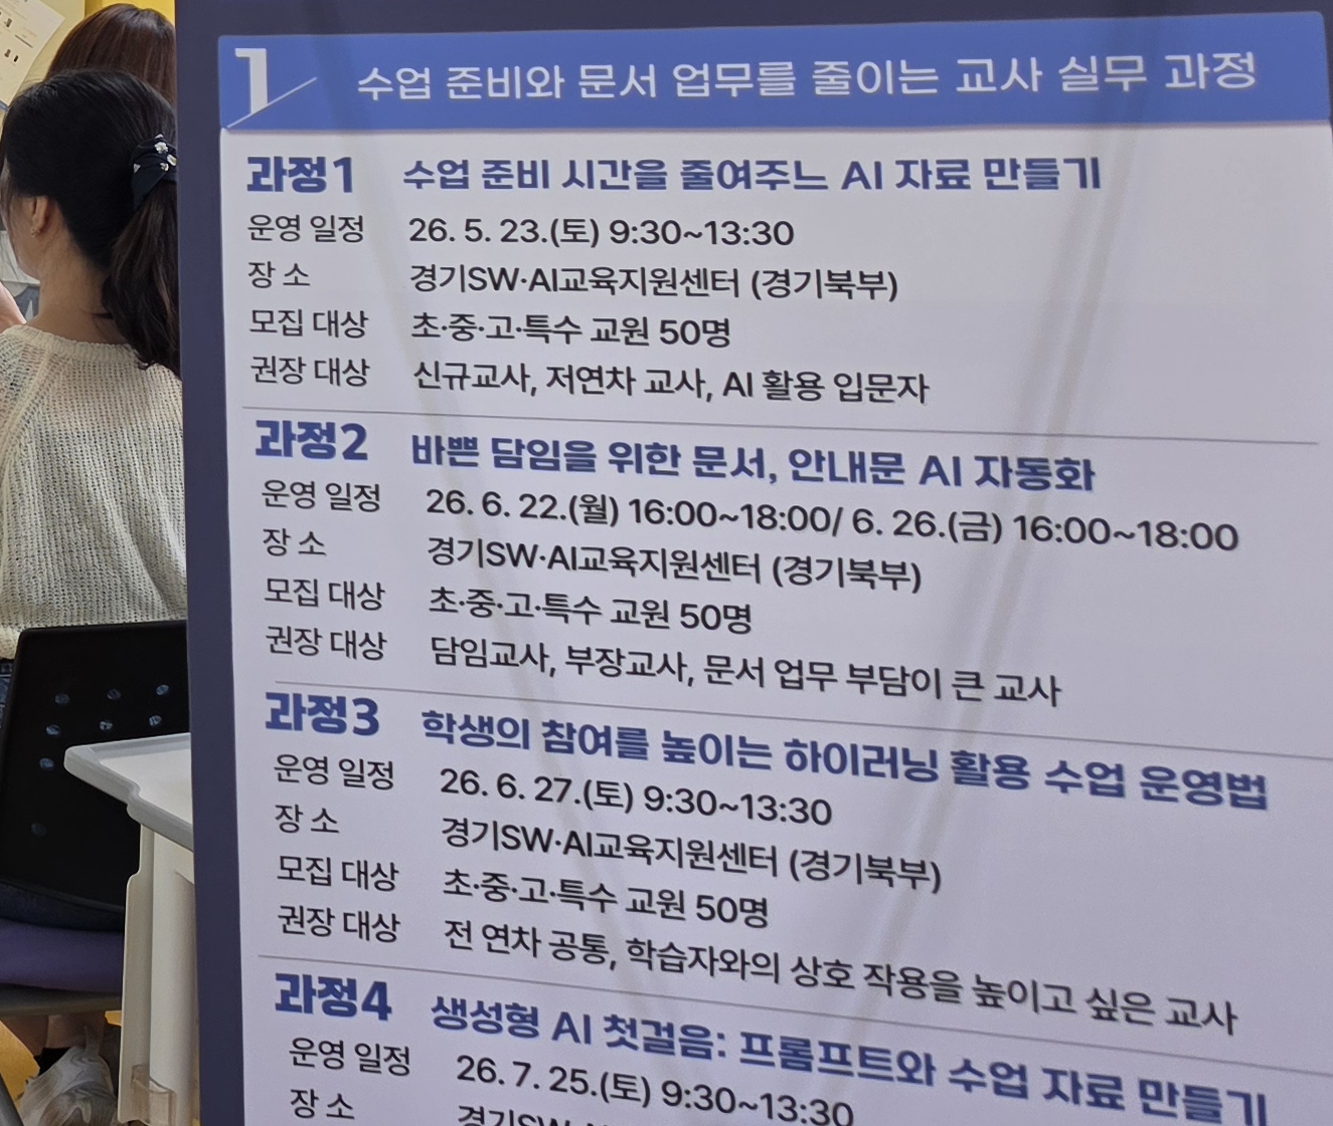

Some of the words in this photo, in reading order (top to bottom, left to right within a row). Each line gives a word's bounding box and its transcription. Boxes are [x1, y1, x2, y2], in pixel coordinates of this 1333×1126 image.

[358, 67, 430, 101] 수업
[447, 65, 565, 99] 준비와
[579, 64, 656, 98] 문서
[673, 62, 796, 97] 업무를
[812, 60, 939, 95] 줄이는
[956, 57, 1043, 92] 교사
[1059, 56, 1146, 91] 실무
[1165, 51, 1255, 89] 과정
[248, 156, 352, 193] 과정1
[403, 160, 469, 189] 수업
[482, 160, 549, 189] 준비
[562, 159, 668, 190] 시간을
[680, 160, 829, 191] 줄여주느
[841, 161, 882, 190] AI
[895, 159, 971, 190] 자료
[984, 157, 1101, 190] 만들기
[248, 214, 300, 242] 운영
[310, 215, 363, 243] 일정
[409, 218, 455, 242] 26.
[465, 218, 491, 242] 5.
[500, 218, 599, 248] 23.(토)
[609, 220, 794, 245] 9:30~13:30
[248, 261, 276, 288] 장
[283, 263, 310, 286] 소
[752, 269, 898, 302] (경기북부)
[250, 309, 303, 337] 모집
[313, 310, 369, 339] 대상
[590, 316, 649, 346] 교원
[660, 318, 730, 348] 50명
[251, 356, 307, 385] 권장
[314, 357, 370, 387] 대상
[414, 361, 537, 397] 신규교사,
[546, 364, 637, 396] 저연차
[644, 368, 713, 403] 교사,
[722, 372, 753, 397] AI
[762, 370, 825, 401] 활용
[834, 372, 930, 404] 입문자
[255, 420, 368, 460] 과정2
[412, 435, 480, 467] 바쁜
[491, 438, 597, 473] 담임을
[608, 442, 681, 476] 위한
[693, 446, 777, 485] 문서,
[788, 449, 905, 485] 안내문
[919, 455, 962, 487] AI
[974, 456, 1096, 491] 자동화
[426, 489, 473, 515] 26.
[482, 491, 510, 517] 6.
[519, 493, 619, 528] 22.(월)
[629, 499, 844, 537] 16:00~18:00/
[852, 508, 883, 536] 6.
[893, 510, 1002, 544] 26.(금)
[1013, 515, 1239, 551] 16:00~18:00
[773, 556, 921, 594] (경기북부)
[431, 636, 556, 678] 담임교사,
[565, 645, 694, 687] 부장교사,
[704, 655, 764, 688] 문서
[774, 659, 838, 692] 업무
[846, 663, 941, 700] 부담이
[951, 671, 985, 702] 큰
[993, 674, 1062, 708] 교사
[265, 692, 379, 736] 과정3
[422, 710, 530, 750] 학생의
[542, 719, 649, 761] 참여를
[661, 730, 772, 770] 높이는
[784, 738, 939, 783] 하이러닝
[950, 750, 1031, 790] 활용
[1045, 760, 1126, 798] 수업
[1140, 766, 1268, 810] 운영법
[440, 768, 488, 796] 26.
[497, 773, 525, 800] 6.
[534, 776, 633, 814] 27.(토)
[644, 785, 832, 826] 9:30~13:30
[275, 973, 392, 1021] 과정4
[444, 920, 473, 951] 전
[482, 924, 542, 958] 연차
[548, 930, 617, 971] 공통,
[625, 937, 779, 984] 학습자와의
[790, 956, 855, 989] 상호
[863, 964, 963, 1004] 작용을
[971, 974, 1077, 1014] 높이고
[1085, 988, 1156, 1027] 싶은
[1165, 998, 1238, 1036] 교사
[431, 996, 539, 1039] 생성형
[551, 1012, 591, 1045] AI
[603, 1014, 726, 1060] 첫걸음:
[740, 1032, 936, 1087] 프롬프트와
[948, 1058, 1029, 1100] 수업
[1042, 1068, 1125, 1111] 자료
[1138, 1078, 1267, 1126] 만들기
[457, 1055, 505, 1085] 26.
[513, 1061, 540, 1089] 7.
[549, 1066, 650, 1108] 25.(토)
[661, 1067, 854, 1126] 9:30~13:30
